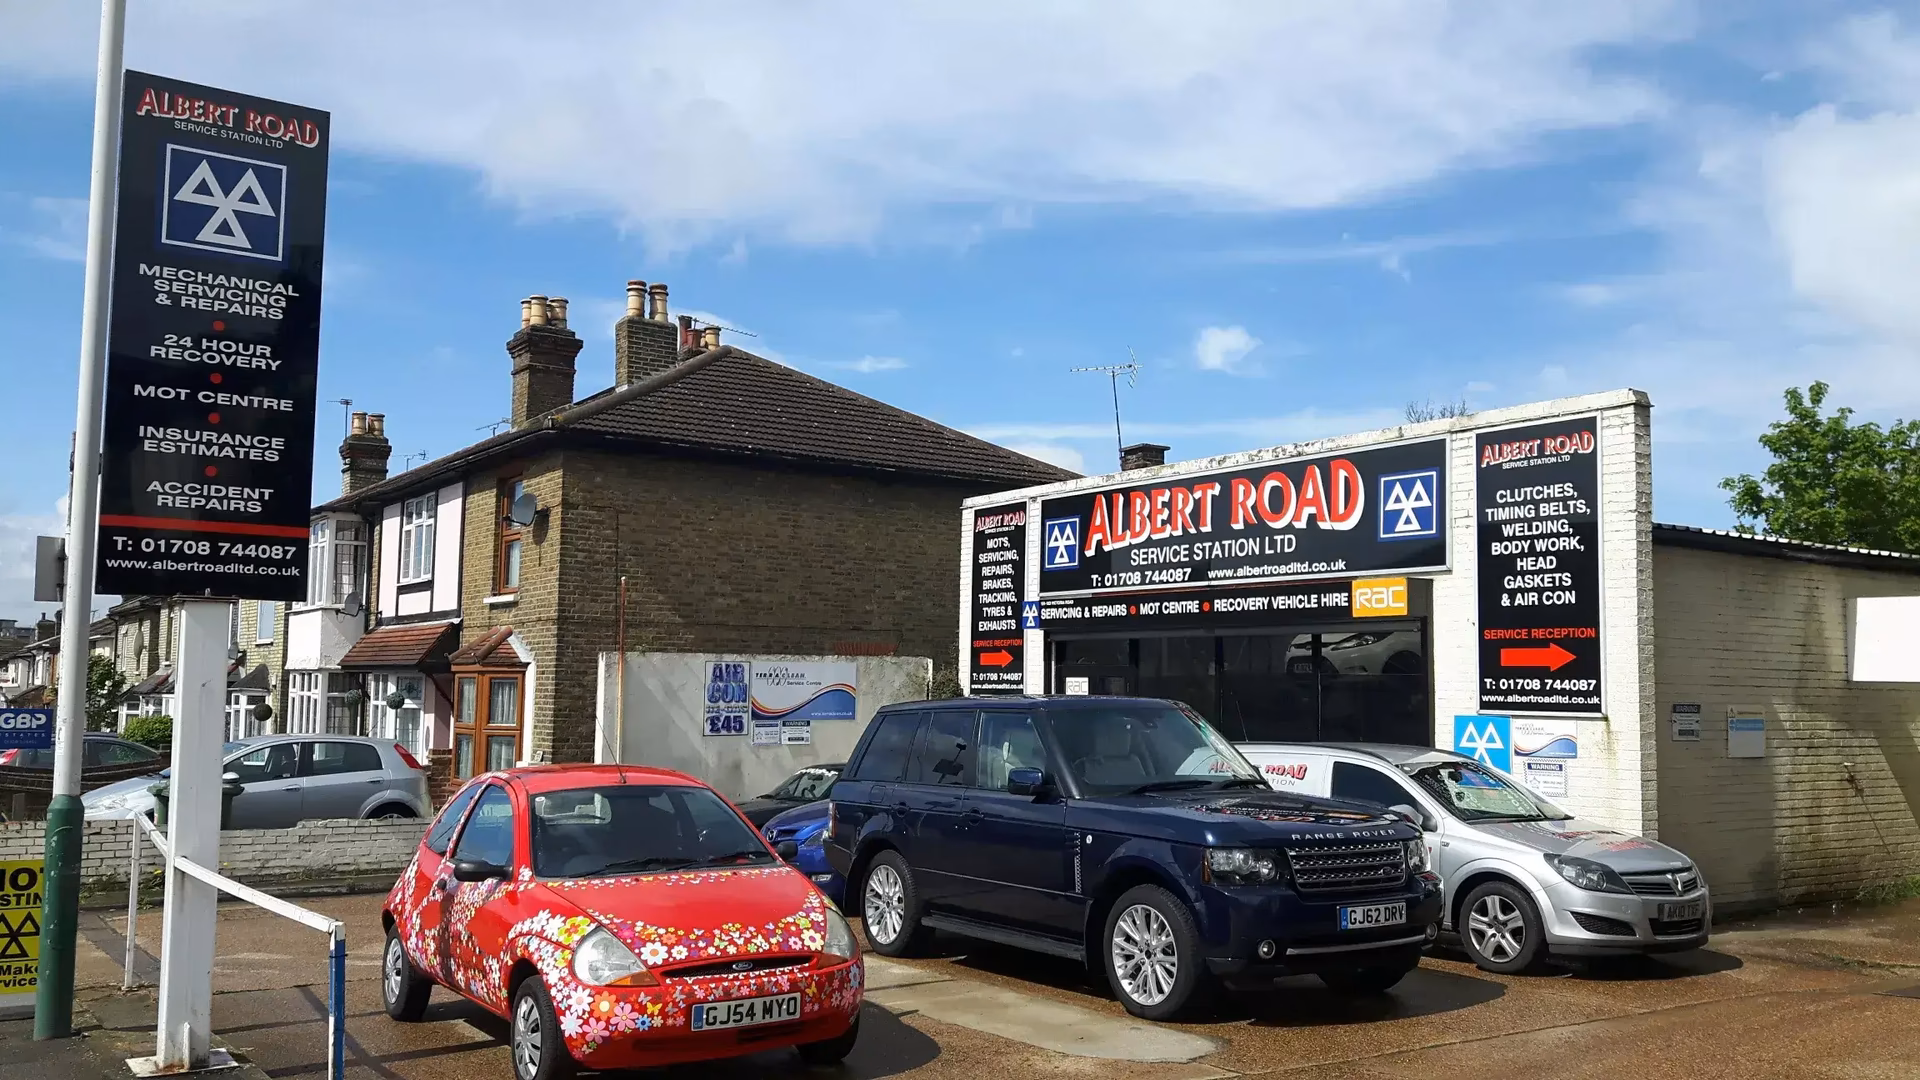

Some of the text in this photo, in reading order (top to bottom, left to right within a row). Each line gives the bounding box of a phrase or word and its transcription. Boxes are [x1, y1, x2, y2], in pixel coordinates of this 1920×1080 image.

[136, 88, 319, 148] ALBERT ROAD
[174, 120, 284, 149] SERVICE STATION LTD
[139, 263, 299, 297] MECHANICAL
[153, 280, 287, 308] SERVICING
[155, 294, 284, 320] & REPAIRS
[164, 334, 272, 357] 24 HOUR
[150, 345, 282, 371] RECOVERY
[134, 384, 294, 412] MOT CENTRE
[138, 425, 285, 450] INSURANCE
[143, 439, 280, 462] ESTIMATES
[1481, 430, 1595, 468] ALBERT ROAD
[1502, 454, 1571, 470] SERVICE STATION LTD
[146, 480, 274, 501] ACCIDENT
[1496, 482, 1578, 504] CLUTCHES,
[157, 494, 263, 513] REPAIRS
[1084, 458, 1365, 557] ALBERT ROAD
[1486, 500, 1591, 522] TIMING BELTS,
[976, 510, 1026, 533] ALBERT ROAD
[1502, 519, 1574, 537] WELDING,
[112, 536, 297, 560] T: 01708 744087
[1130, 534, 1297, 566] SERVICE STATION LTD
[1491, 536, 1585, 556] BODY WORK,
[978, 550, 1019, 564] SERVICING,
[1516, 556, 1557, 571] HEAD
[106, 558, 300, 577] www.albertroadltd.co.uk
[982, 564, 1015, 577] REPAIRS,
[1091, 558, 1347, 587] T: 01708 744087 www.albertroadltd.co.uk
[982, 577, 1014, 590] BRAKES,
[1504, 572, 1572, 589] GASKETS
[978, 591, 1018, 604] TRACKING,
[1041, 592, 1349, 620] SERVICING & REPAIRS MOT CENTRE RECOVERY VEHICLE HIRE
[1501, 590, 1576, 607] & AIR CON
[982, 605, 1013, 617] TYRES &
[979, 619, 1016, 632] EXHAUSTS
[1484, 628, 1596, 640] SERVICE RECEPTION
[973, 639, 1023, 648] SERVICE RECEPTION
[1484, 679, 1596, 691] T: 01708 744087
[1482, 694, 1600, 705] www.albertroadltd.co.uk
[0, 713, 47, 729] GBP
[706, 715, 744, 734] £45
[1265, 764, 1308, 781] ROAD
[1291, 829, 1396, 841] RANGE ROVER
[1350, 905, 1404, 926] GJ62 DRV
[706, 996, 798, 1026] GJ54 MYO
